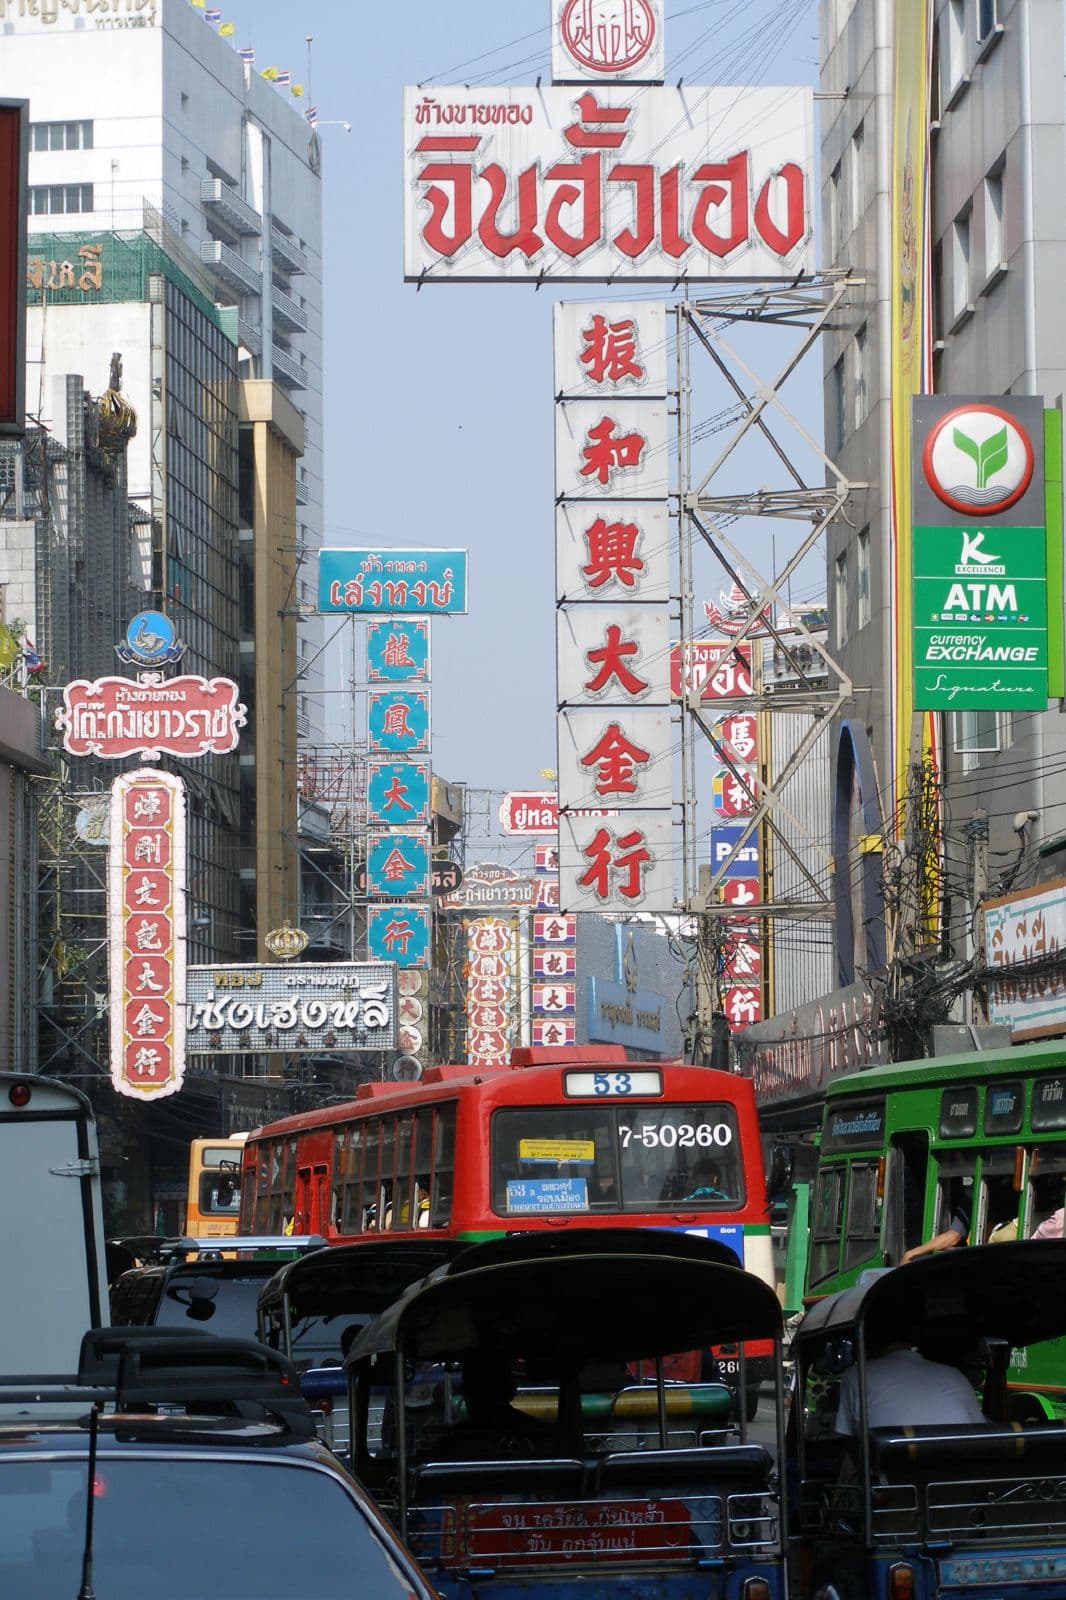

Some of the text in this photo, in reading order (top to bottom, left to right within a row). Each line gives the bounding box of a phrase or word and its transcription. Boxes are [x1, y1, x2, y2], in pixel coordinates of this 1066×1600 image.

[415, 97, 533, 126] ห้างขายทอง
[414, 93, 805, 259] จินฮั้วเฮง
[961, 532, 1002, 565] K
[360, 553, 427, 573] ห้างทอง
[956, 566, 1004, 574] EXCELLENCE
[330, 567, 455, 607] เล่งหงษ์
[944, 583, 1018, 611] ATM
[579, 314, 652, 899] 振和興大金行
[925, 646, 1039, 661] EXCHANGE
[930, 635, 986, 651] currency
[115, 687, 186, 703] ห้างขายทอง
[925, 674, 1035, 700] Signature
[73, 702, 228, 740] โต๊ะกังเยาวราช
[380, 634, 417, 956] 龍鳳大金行
[214, 971, 264, 988] ทอง
[594, 1072, 632, 1096] 53
[618, 1123, 733, 1148] 7-50260
[509, 1184, 526, 1197] 53
